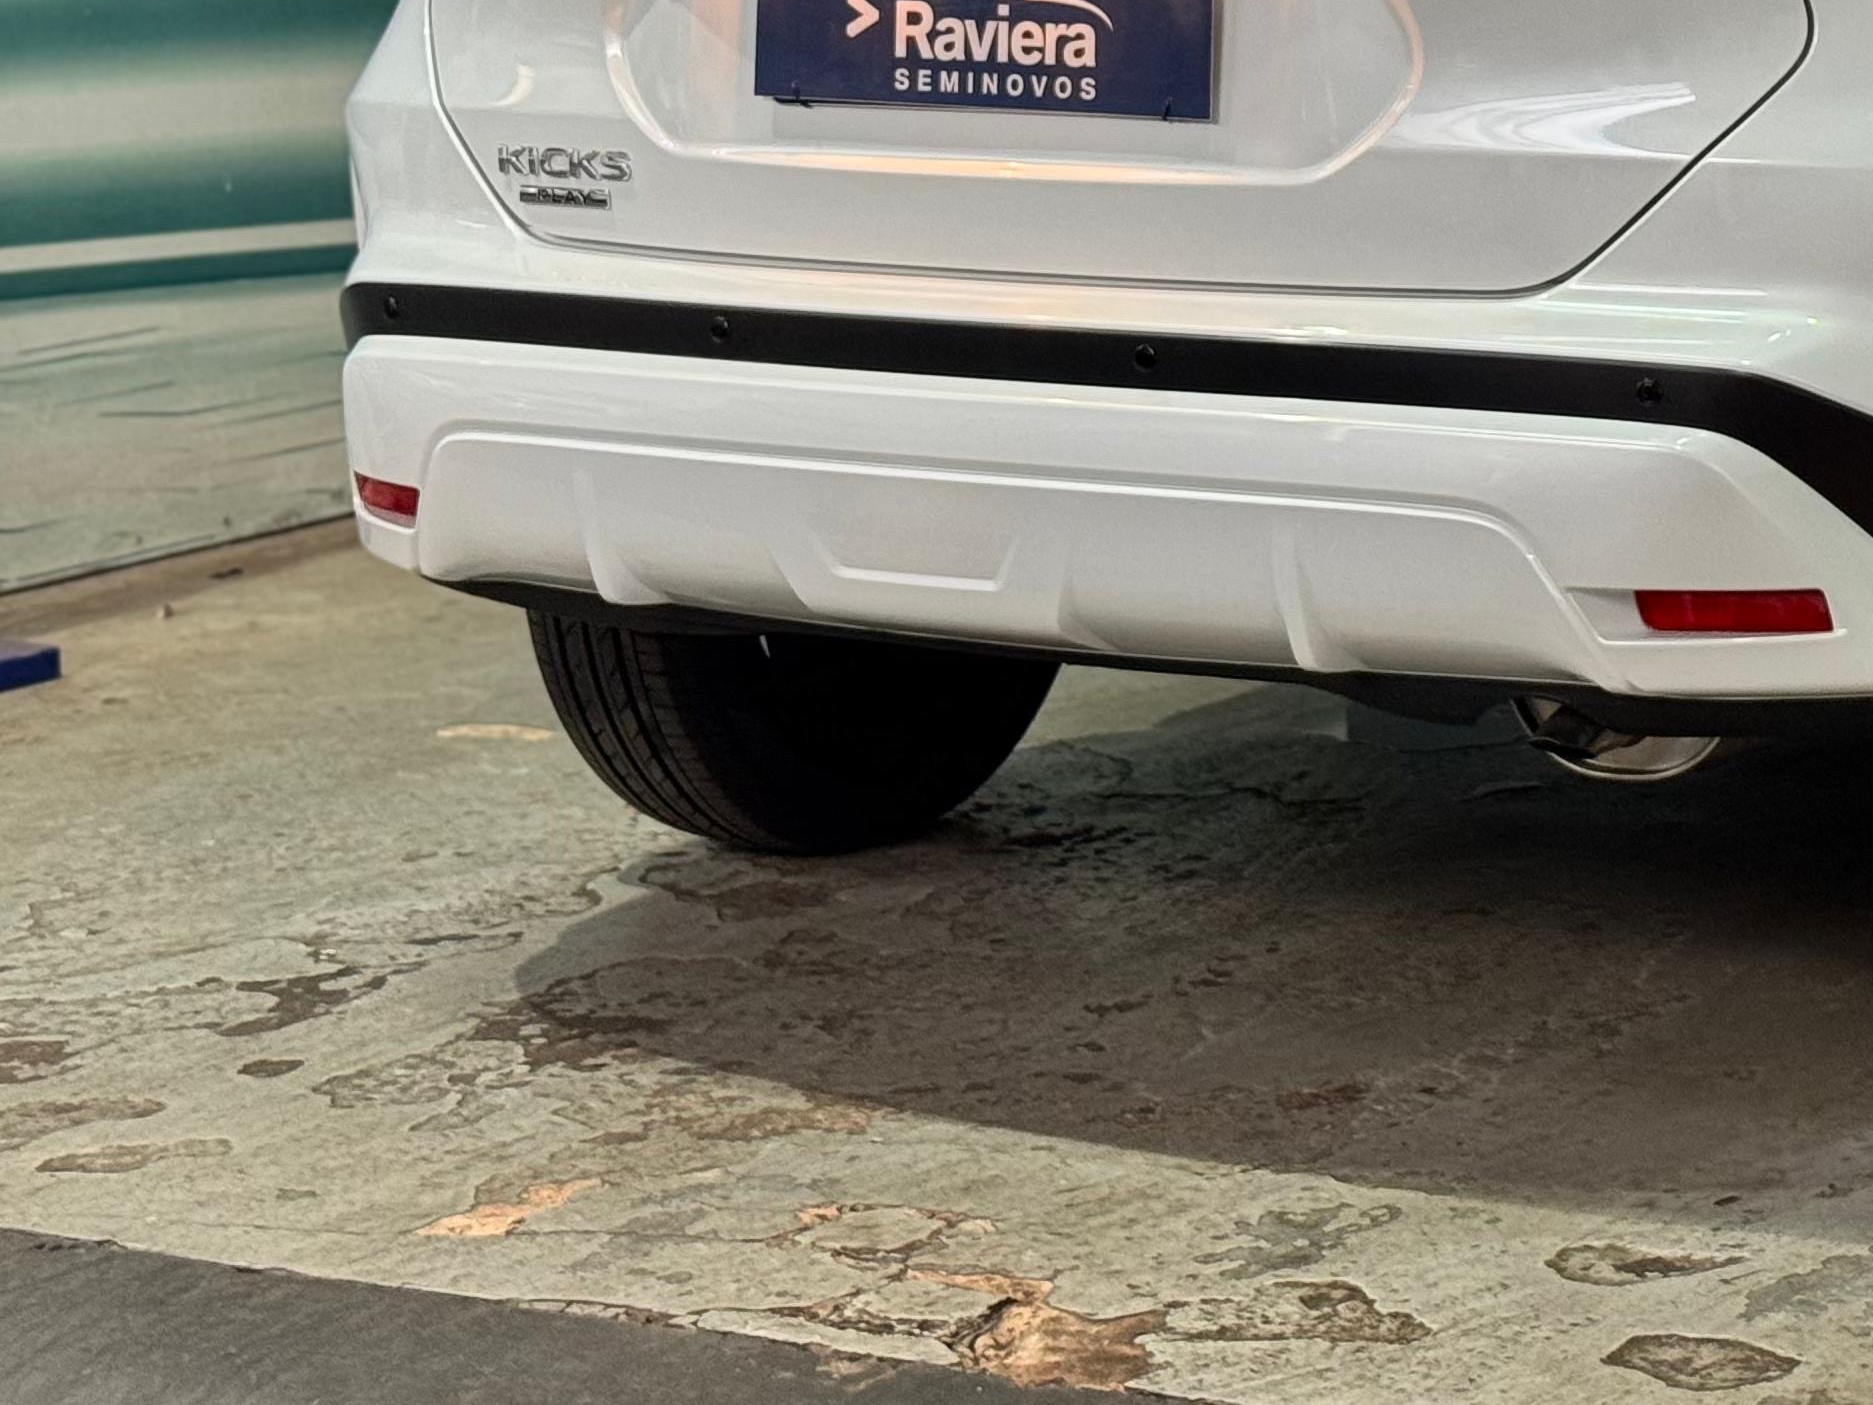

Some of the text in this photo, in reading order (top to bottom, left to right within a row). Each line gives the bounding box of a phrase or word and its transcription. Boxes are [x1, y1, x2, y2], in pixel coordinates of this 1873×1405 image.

[894, 0, 1096, 68] Raviera
[894, 68, 1097, 101] SEMINOVOS
[498, 145, 632, 182] KICKS
